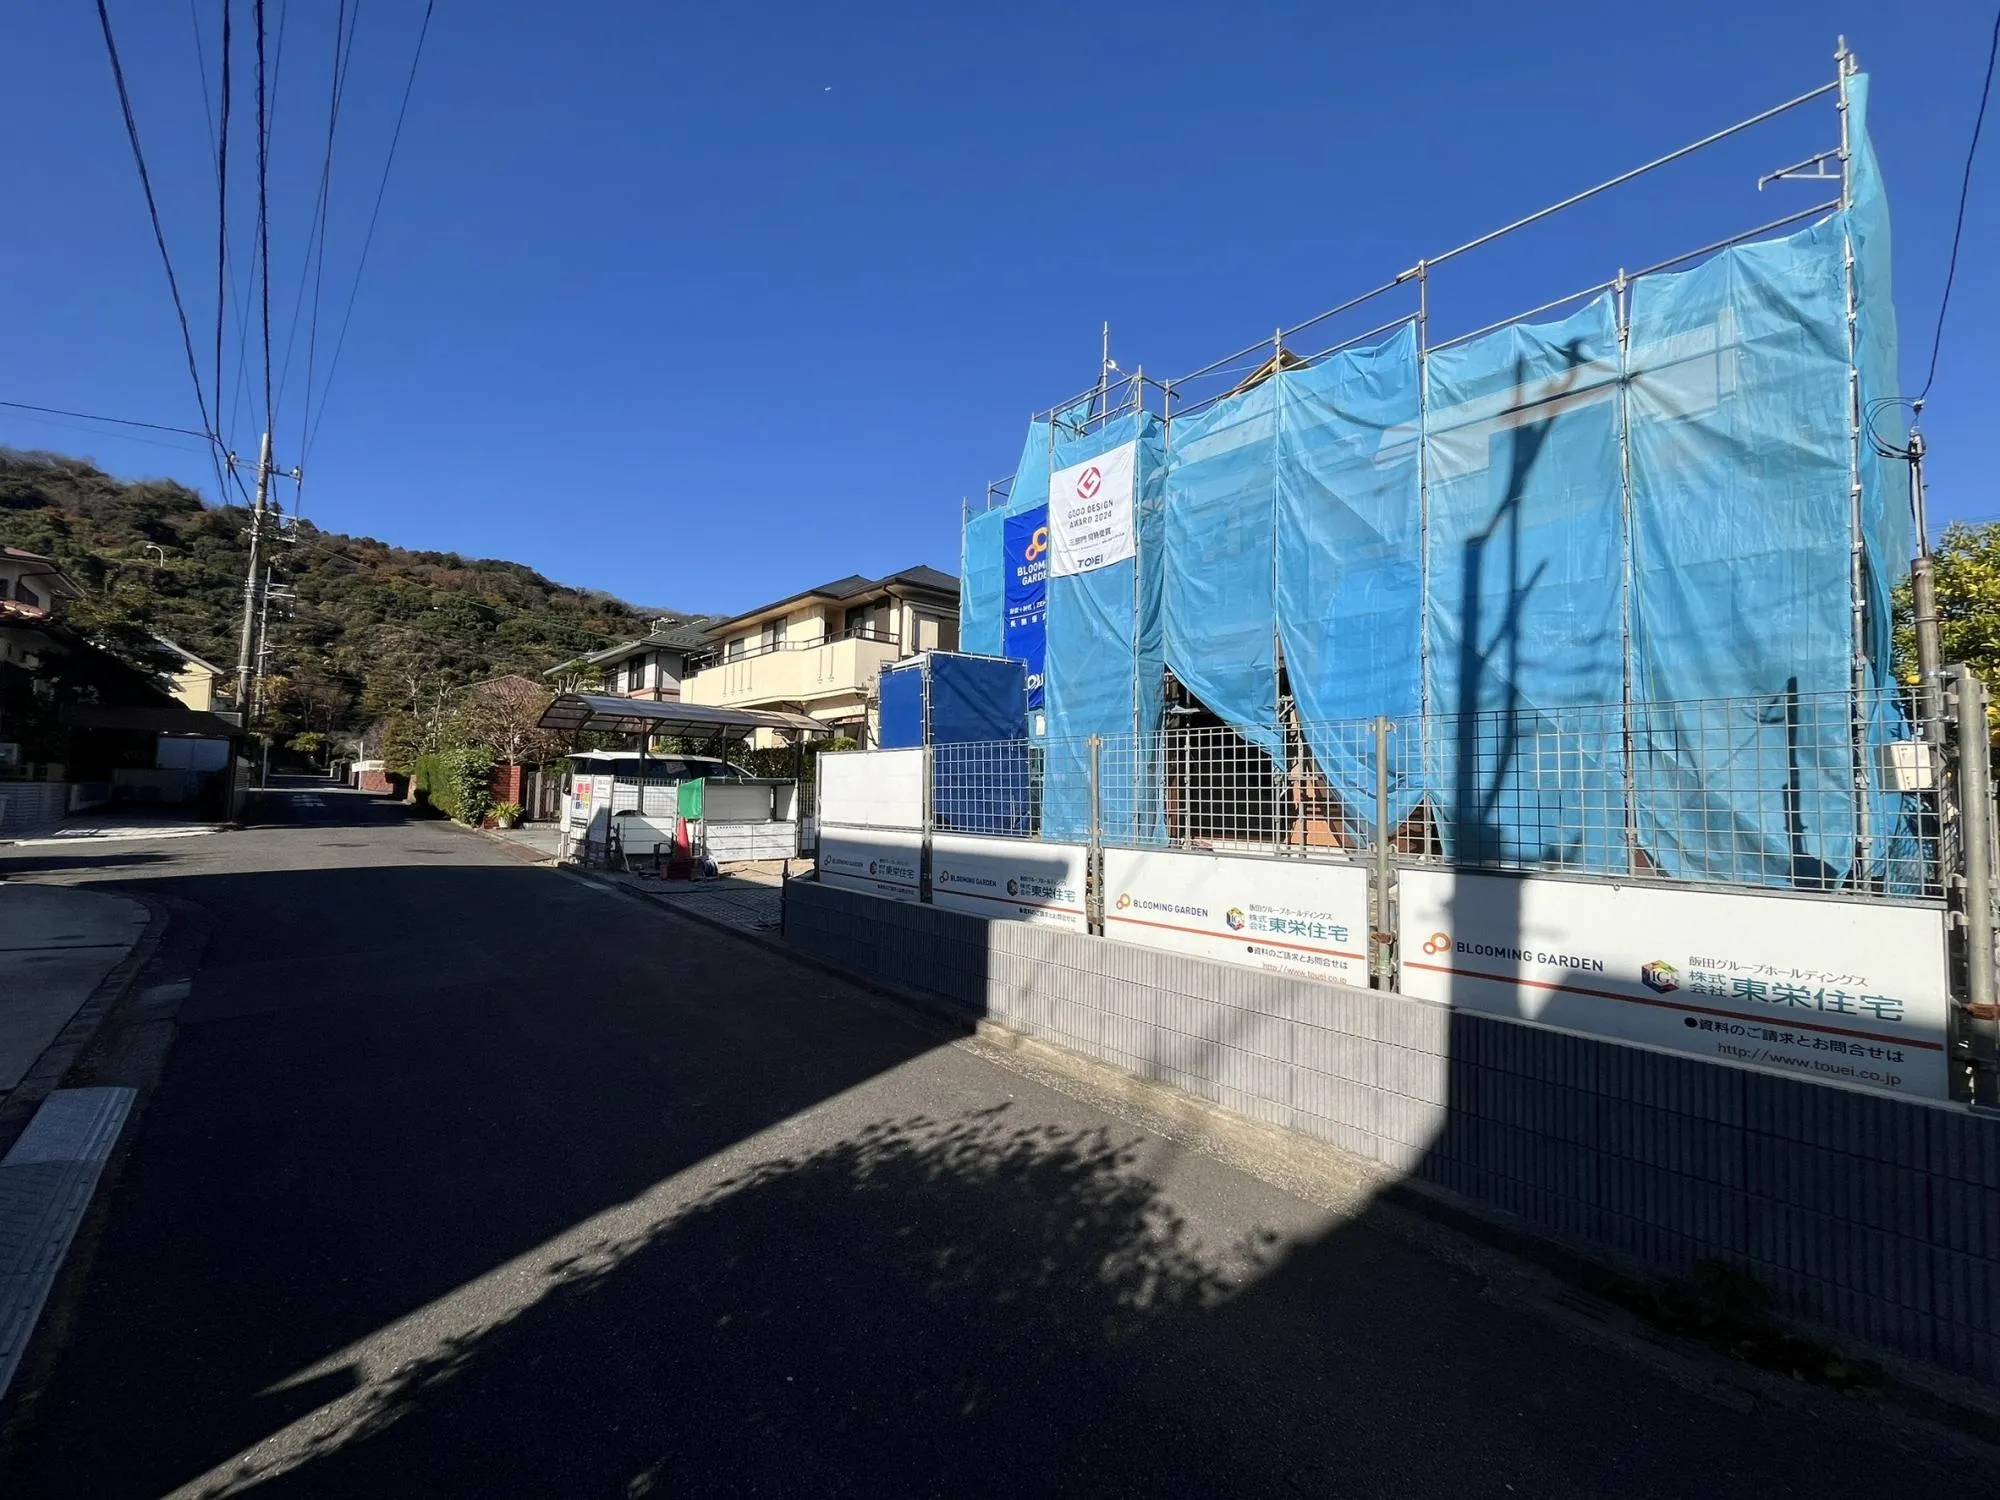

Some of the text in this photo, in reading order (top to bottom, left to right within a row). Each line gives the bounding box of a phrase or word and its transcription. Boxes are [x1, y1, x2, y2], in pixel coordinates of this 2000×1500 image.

[1087, 499, 1114, 513] DESIGN
[1069, 510, 1112, 529] AWARD 2024
[1031, 885, 1076, 903] 東栄住宅
[1133, 899, 1208, 917] BLOOMING GARDEN
[1268, 917, 1348, 943] 東栄住宅
[1456, 941, 1604, 972] BLOOMING GARDEN
[1688, 955, 1869, 988] 飯田グループホールディングス
[1730, 977, 1905, 1022] 東栄住宅
[1717, 1042, 1902, 1086] http://www.touei.co.jp
